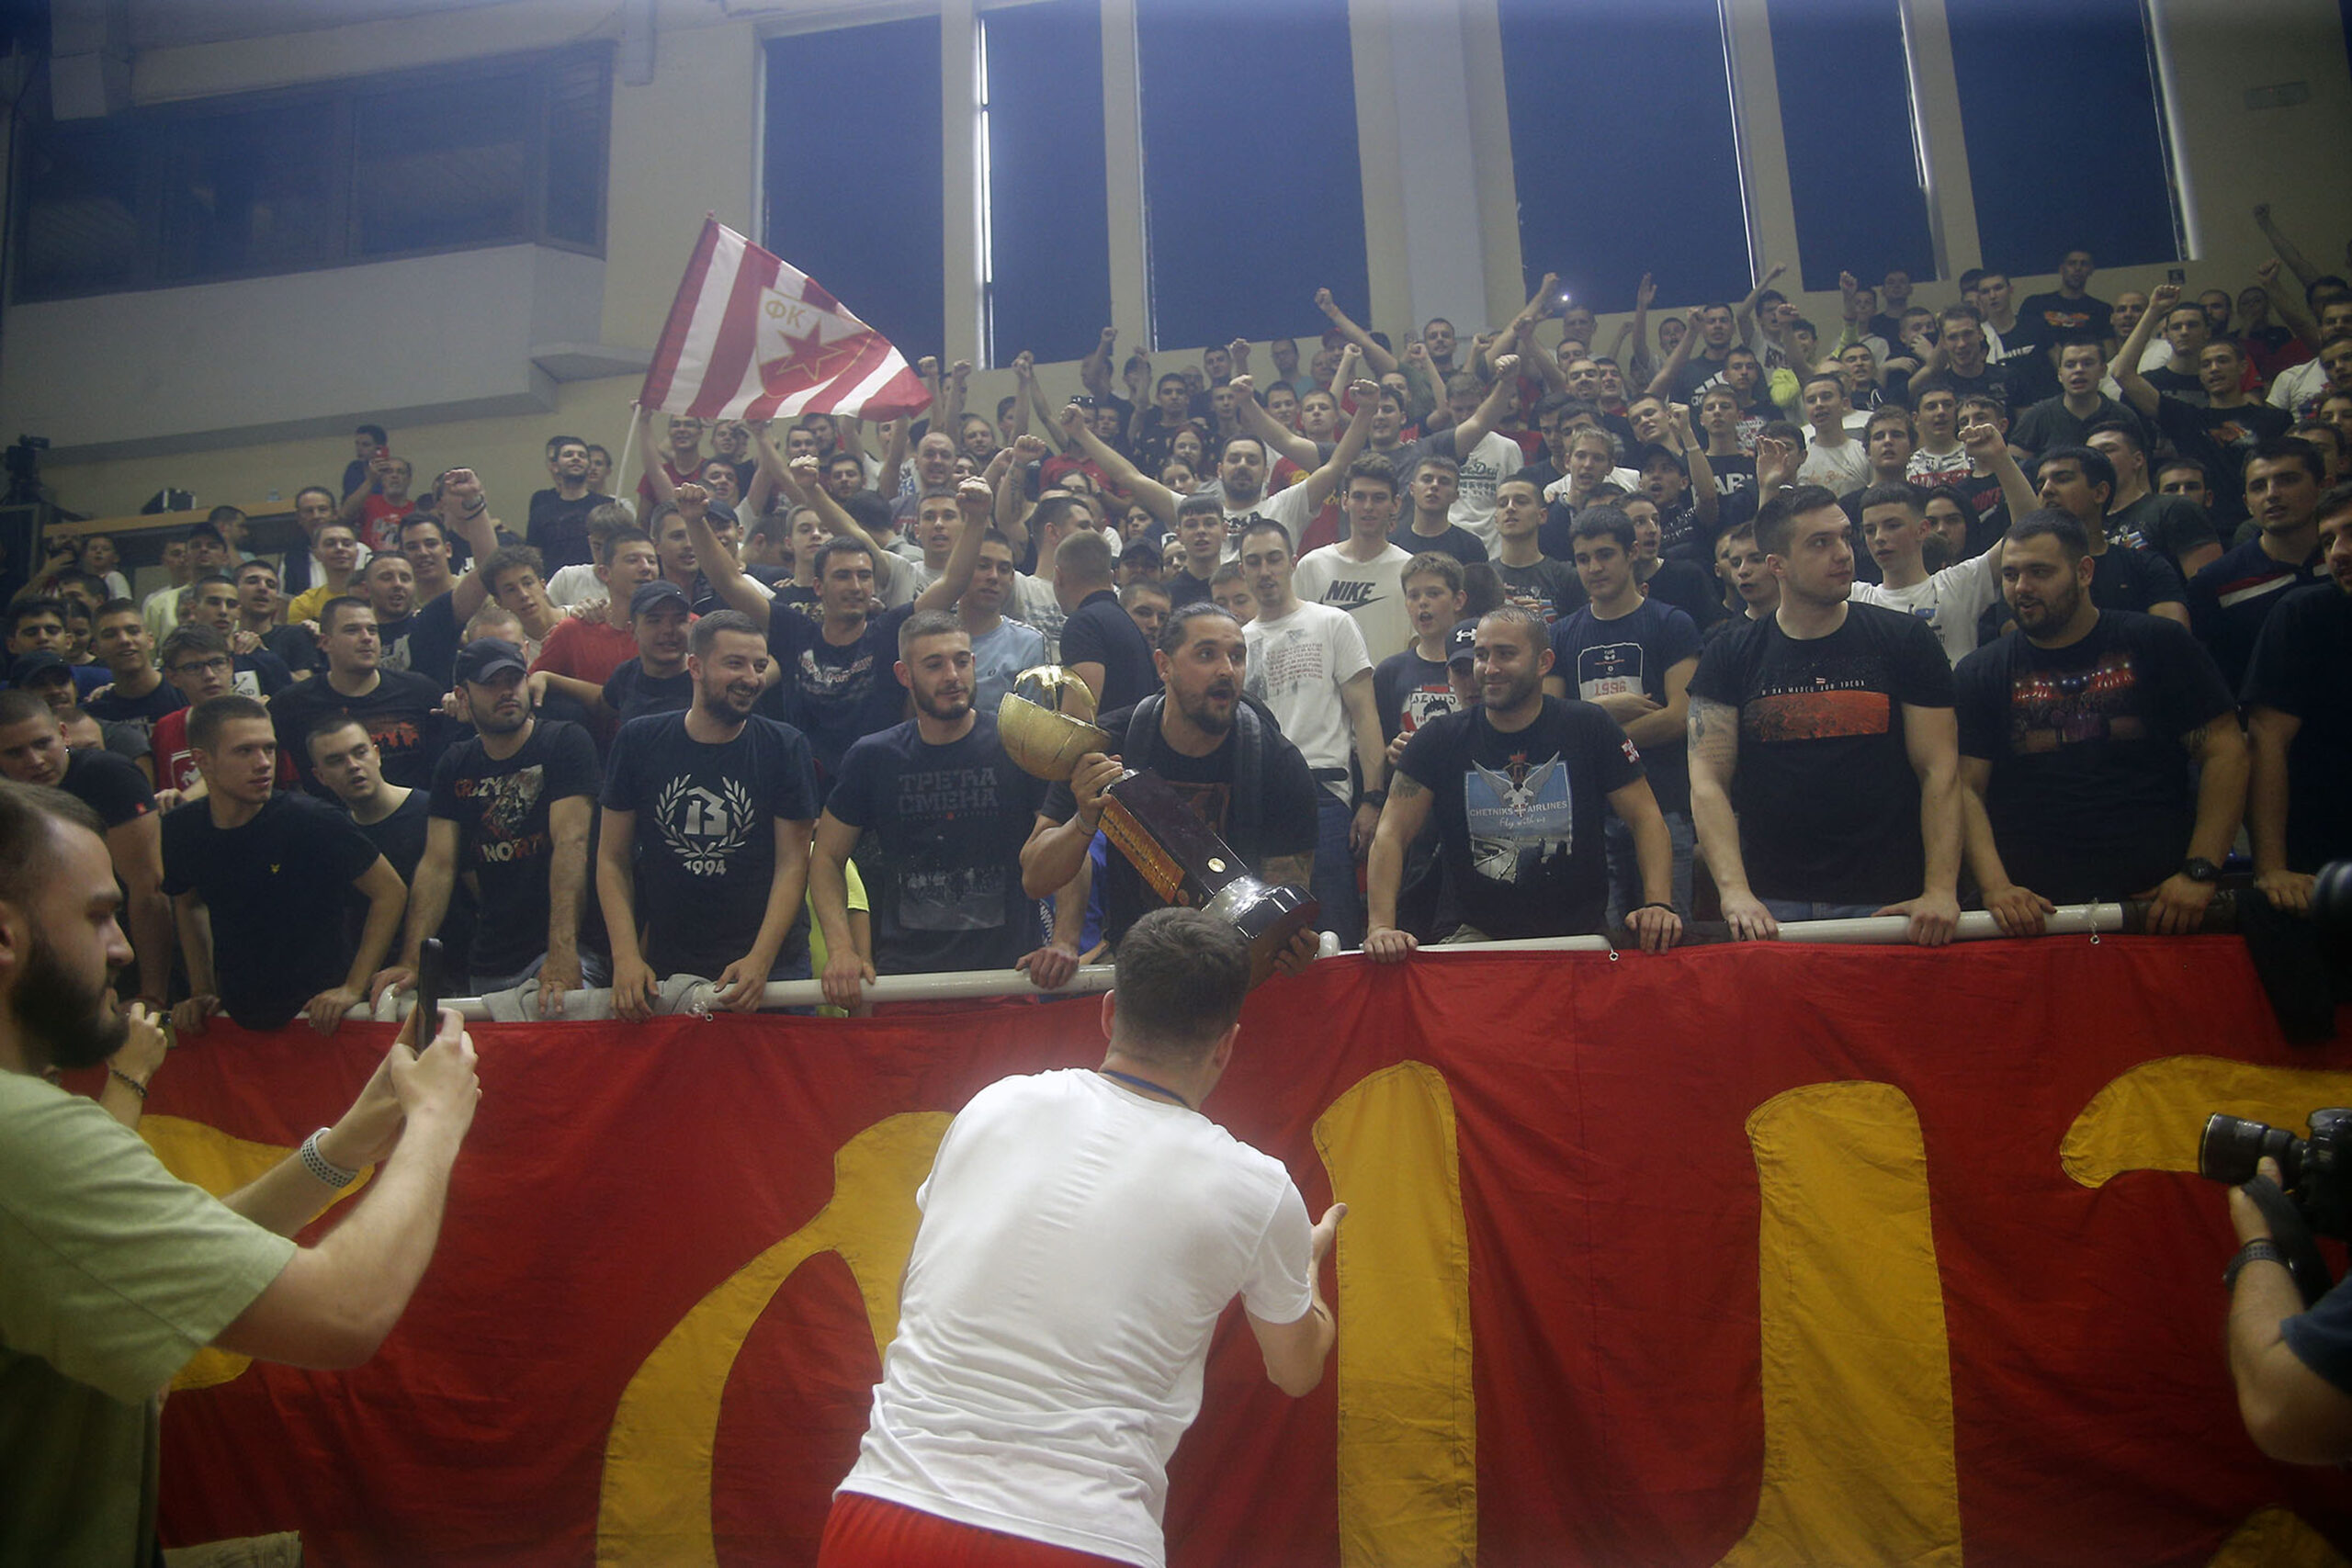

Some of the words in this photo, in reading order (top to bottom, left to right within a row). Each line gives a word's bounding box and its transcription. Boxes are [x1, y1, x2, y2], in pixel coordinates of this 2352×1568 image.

[765, 299, 807, 329] ФК
[1325, 580, 1376, 603] NIKE
[899, 767, 999, 792] ТРЕЋА
[899, 787, 1000, 813] СМЕНА
[1470, 807, 1514, 818] CHETNIKS
[1527, 800, 1568, 814] AIRLINES
[1499, 816, 1514, 829] Fly
[479, 833, 548, 863] NORT
[684, 859, 728, 876] 1994
